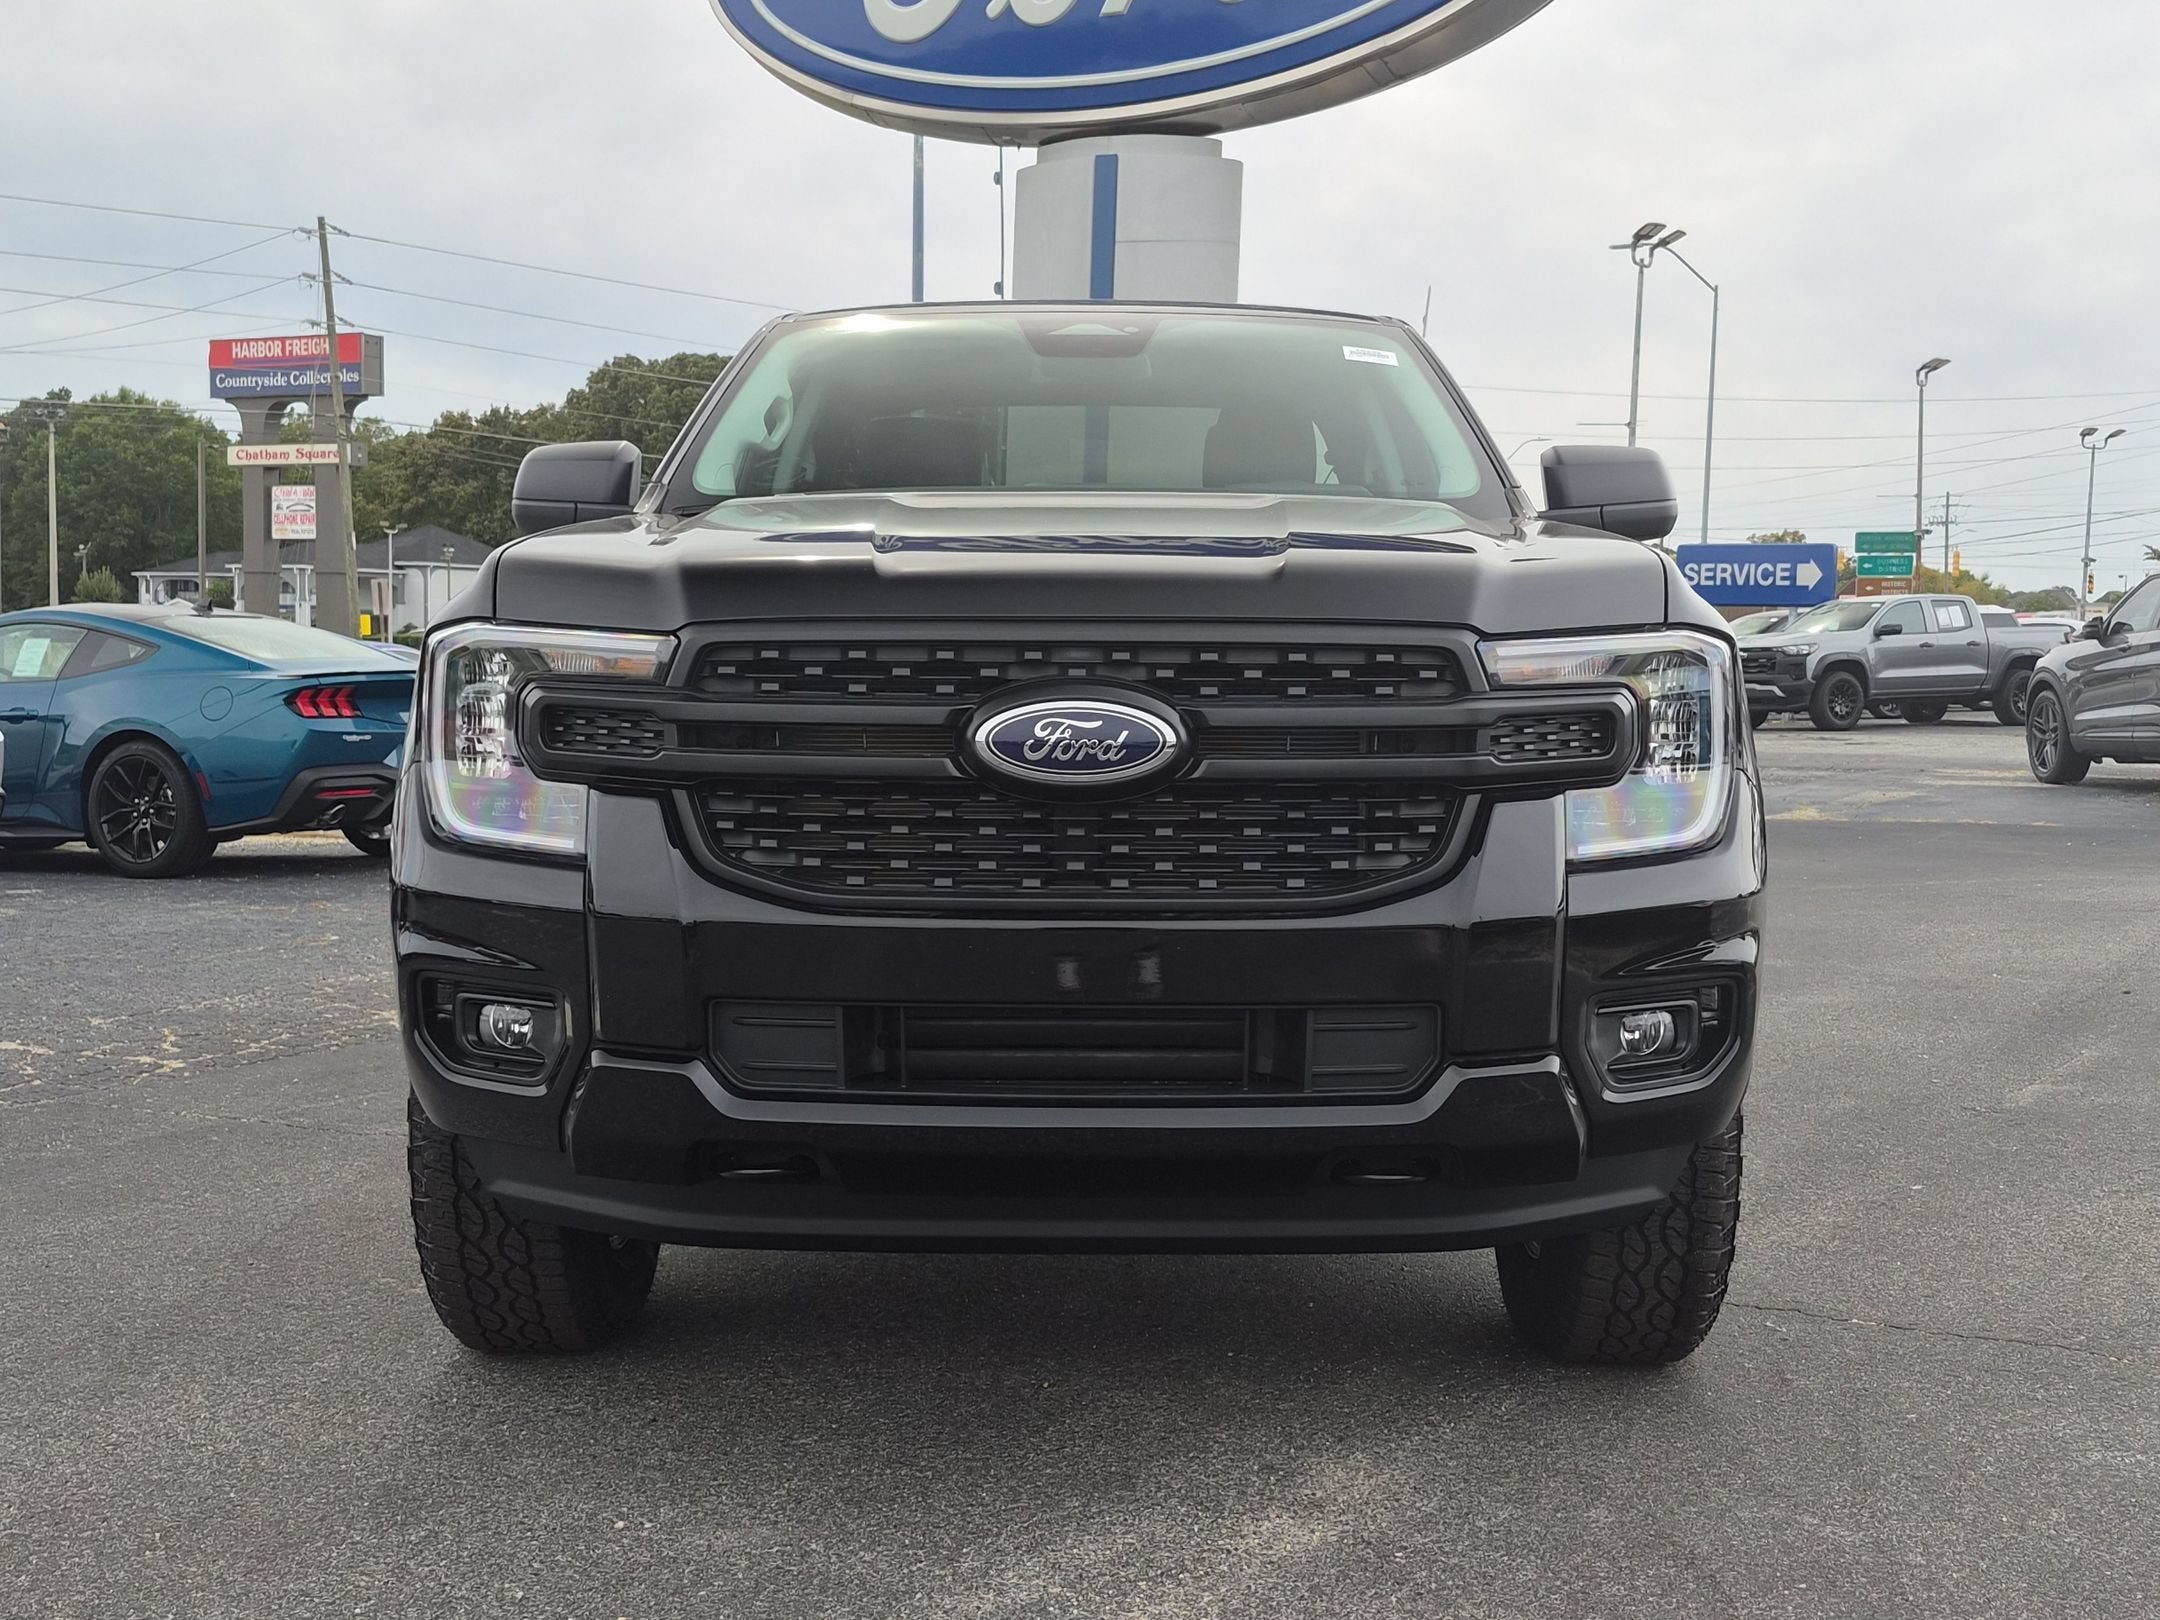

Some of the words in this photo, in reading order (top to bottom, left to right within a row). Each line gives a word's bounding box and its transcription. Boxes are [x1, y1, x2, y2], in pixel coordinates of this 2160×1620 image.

[232, 340, 283, 359] HARBOR
[286, 337, 331, 356] FREIGH
[215, 371, 288, 391] Countryside
[290, 367, 360, 387] Collectles
[236, 448, 290, 462] Chatham
[1684, 562, 1791, 587] SERVICE
[1022, 717, 1130, 762] Ford
